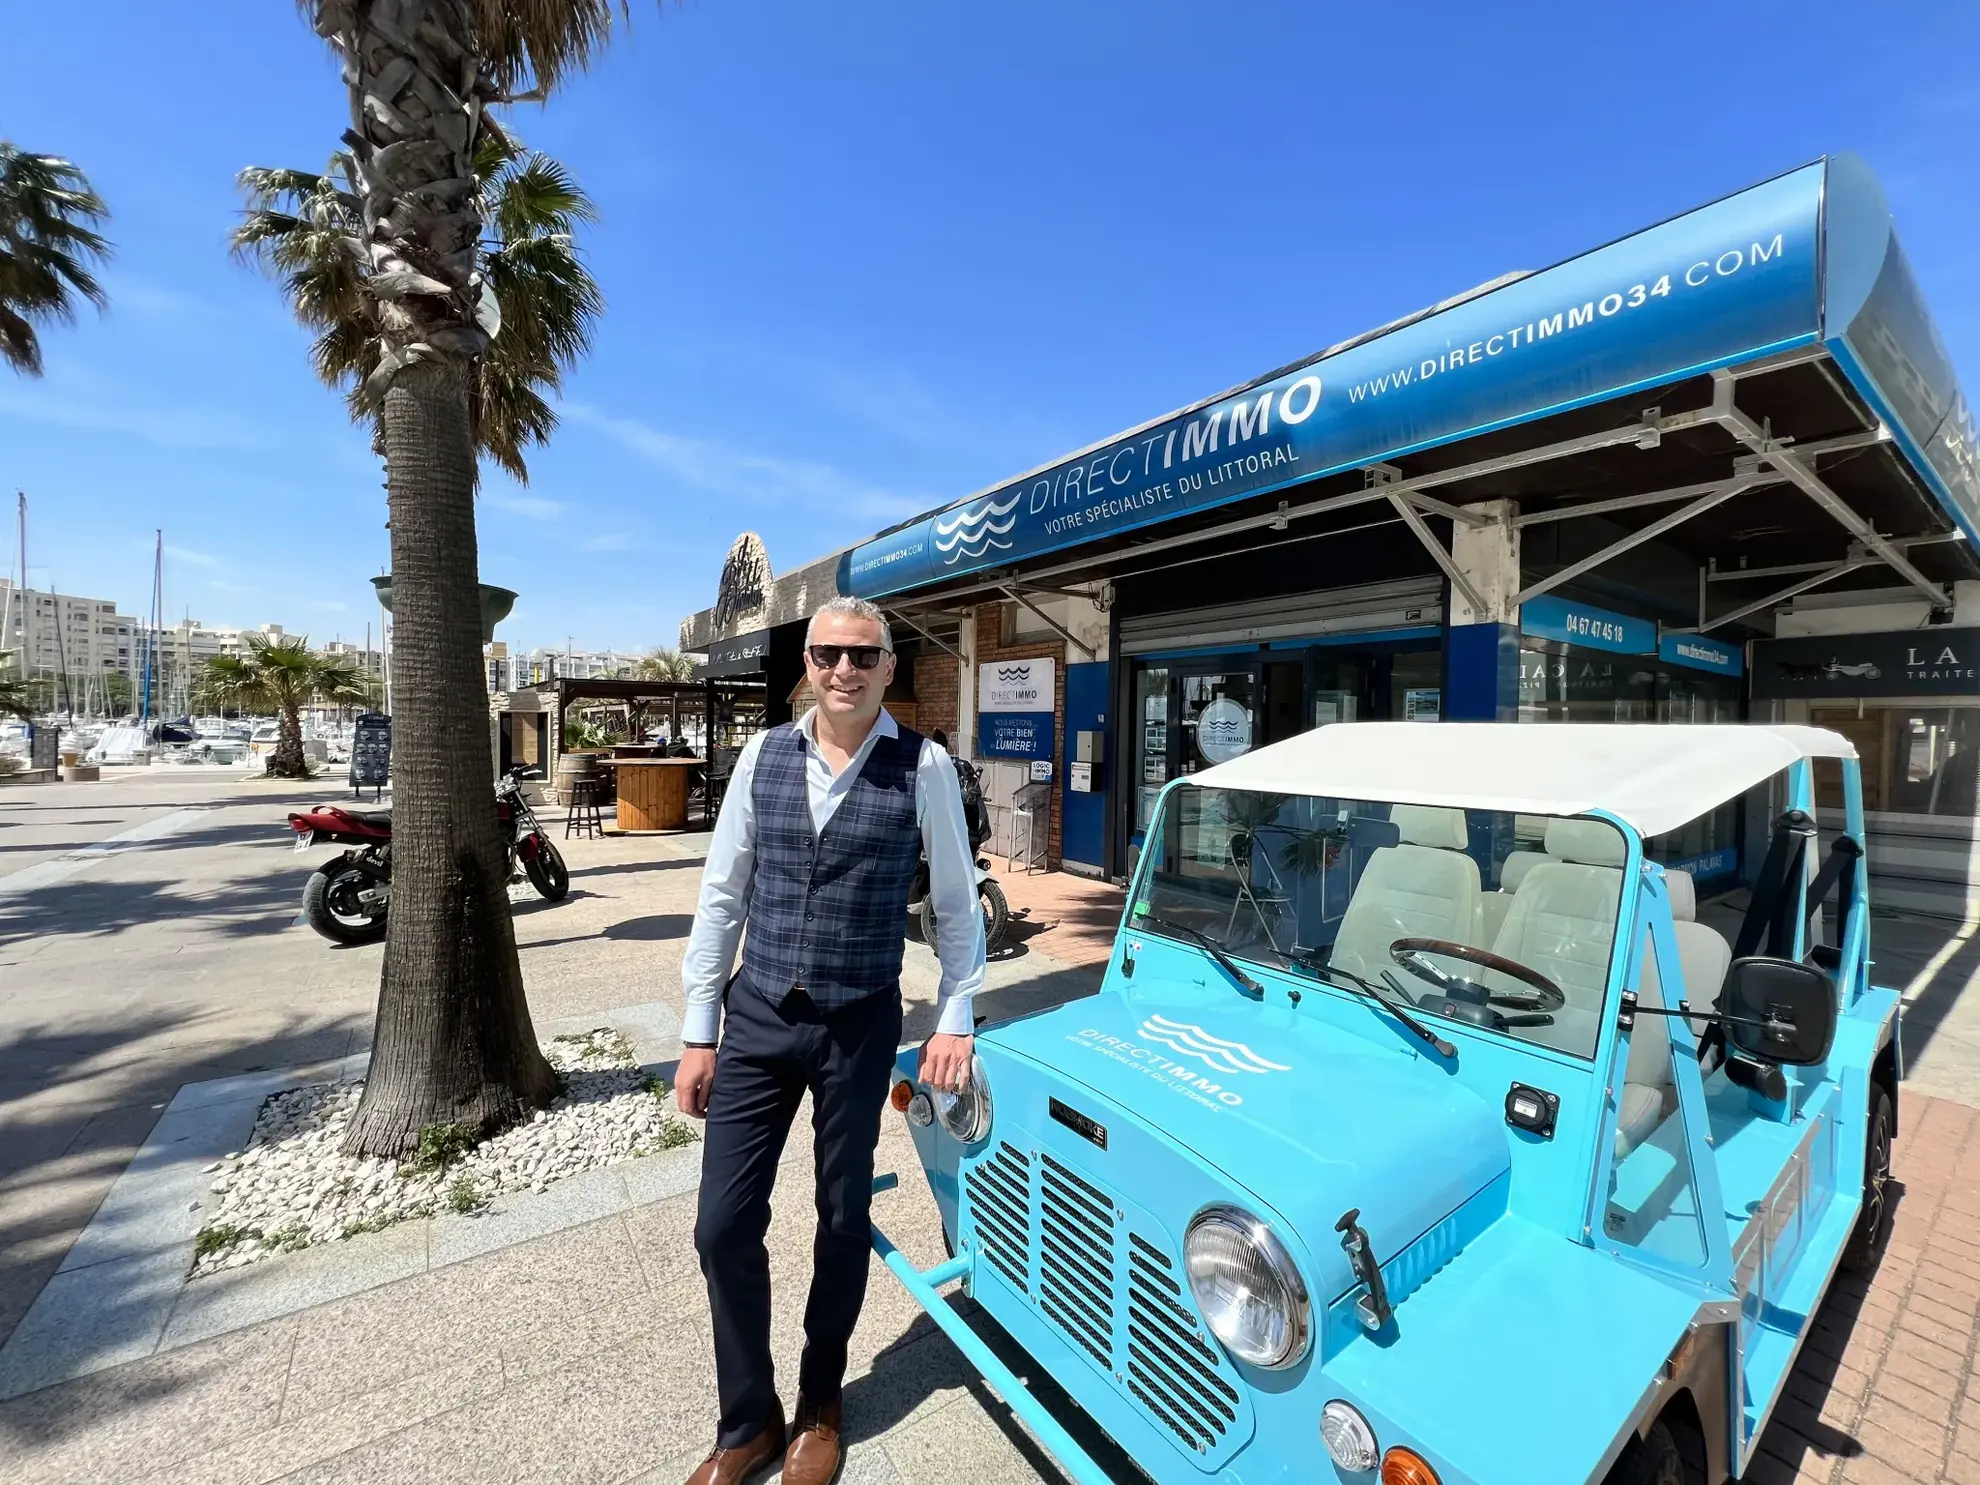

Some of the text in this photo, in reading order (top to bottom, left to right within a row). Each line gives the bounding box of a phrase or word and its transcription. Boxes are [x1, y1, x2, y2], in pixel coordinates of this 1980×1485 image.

[1029, 375, 1322, 515] DIRECTIMMO
[1044, 443, 1300, 535] VOTRE SPÉCIALISTE DU LITTORAL
[1566, 613, 1623, 643] 04 67 47 45 18
[1906, 646, 1960, 666] LA
[991, 690, 1037, 700] DIRECTIMMO
[994, 728, 1033, 738] VOTRE BIEN
[1202, 735, 1244, 743] DIRECTIMMO
[1077, 1028, 1243, 1106] DIRECTIMMO
